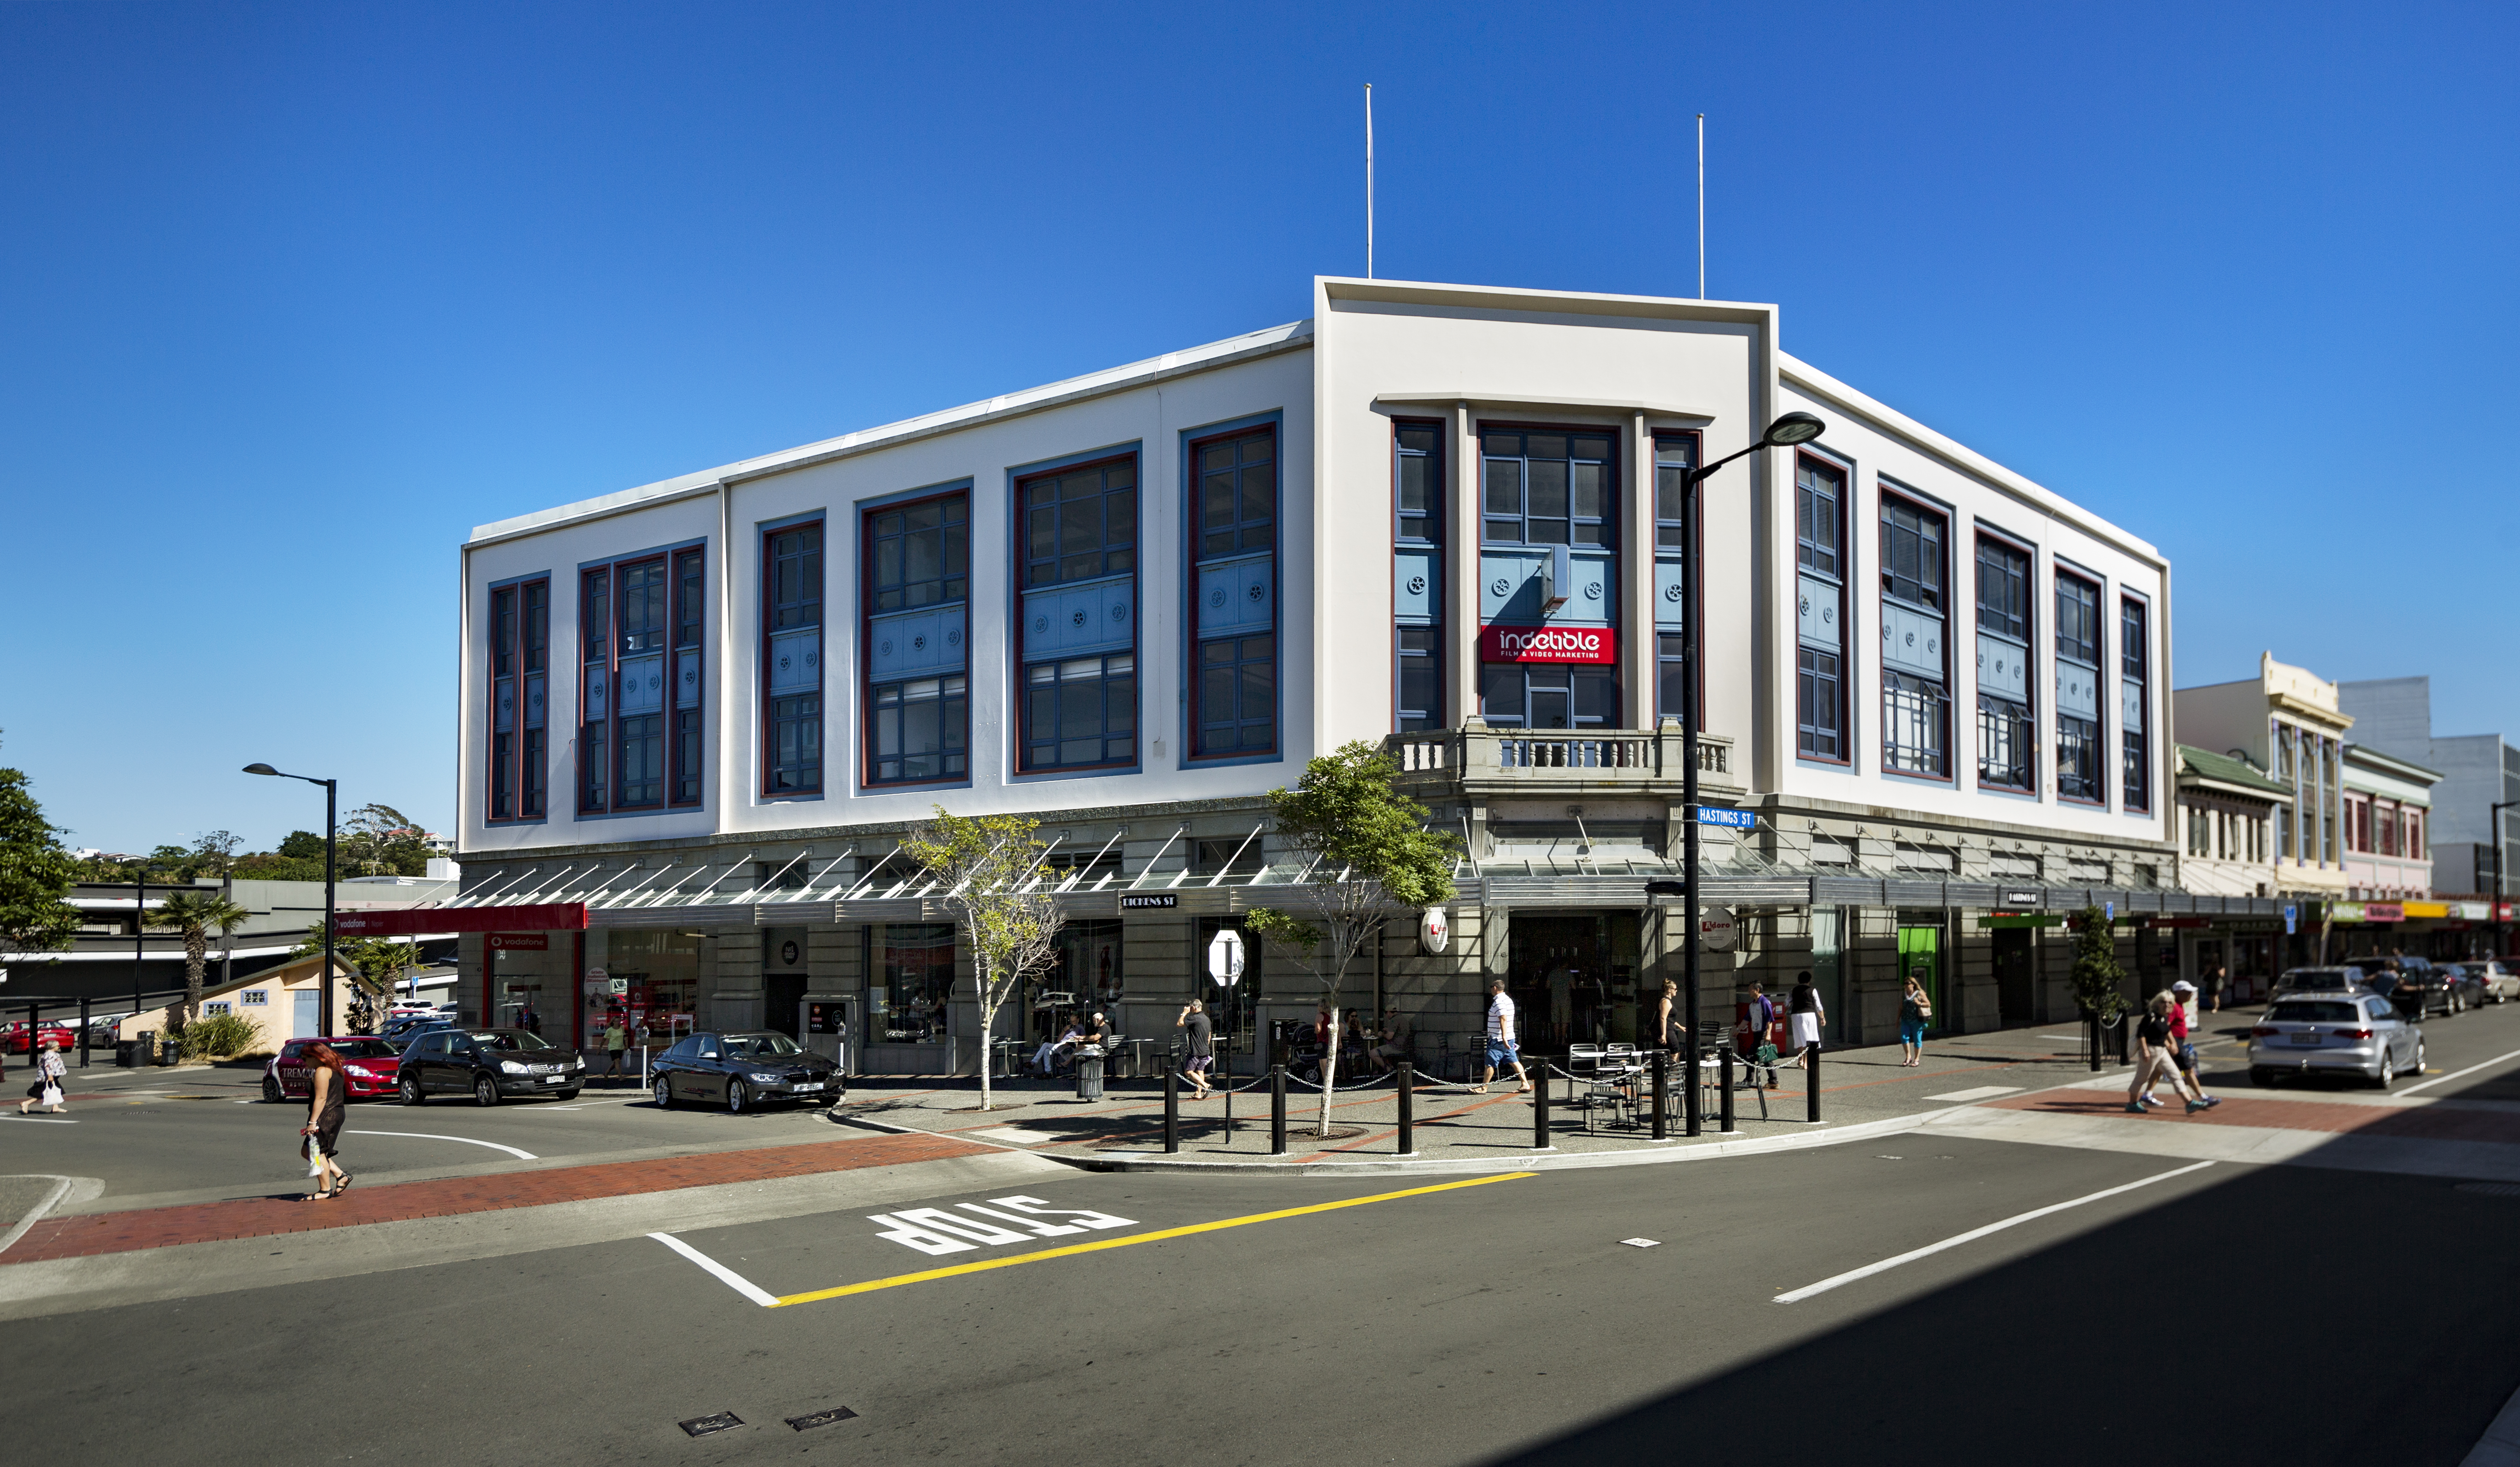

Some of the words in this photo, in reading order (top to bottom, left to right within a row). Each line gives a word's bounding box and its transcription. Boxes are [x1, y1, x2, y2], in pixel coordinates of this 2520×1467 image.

[1500, 630, 1600, 651] indelible
[1700, 809, 1738, 824] HASTINGS
[1741, 813, 1751, 825] ST
[1123, 897, 1162, 906] DICKENS
[1164, 897, 1175, 905] ST
[340, 919, 366, 928] vodafone
[866, 1195, 1140, 1255] STOP
